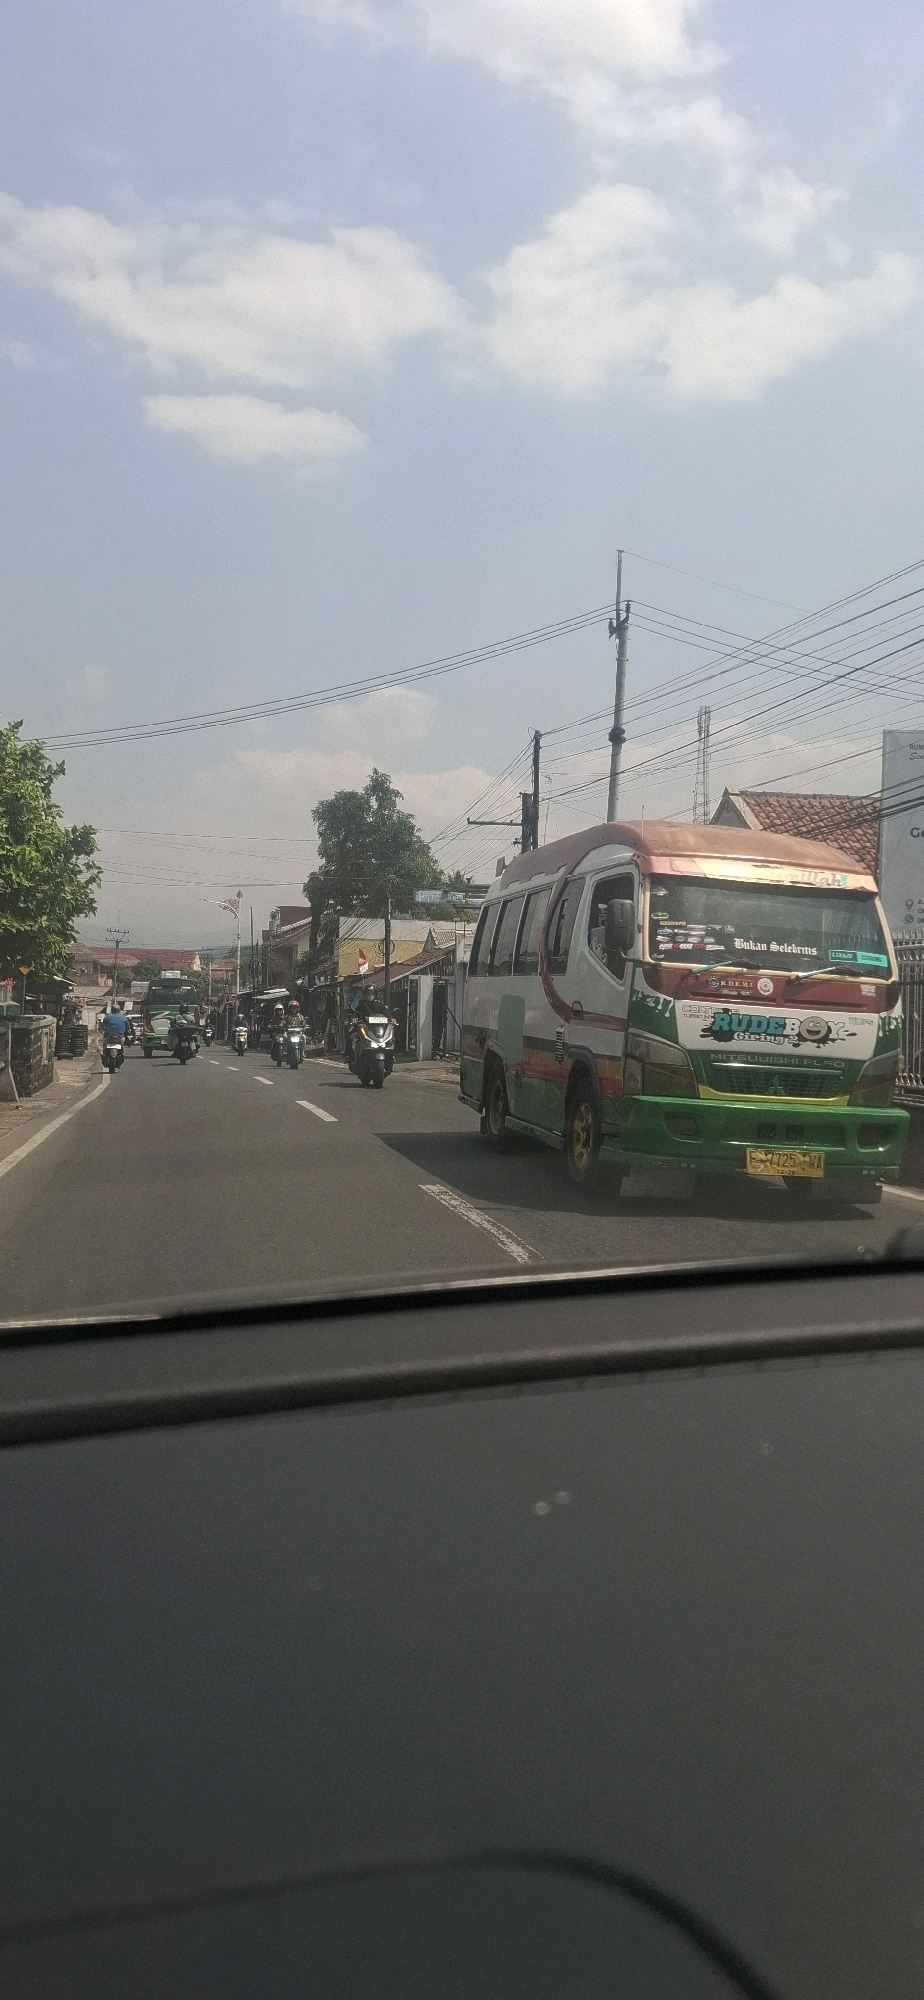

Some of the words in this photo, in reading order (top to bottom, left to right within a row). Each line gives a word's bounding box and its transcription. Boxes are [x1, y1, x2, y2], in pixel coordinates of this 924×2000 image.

[734, 938, 767, 951] Bukan
[733, 1031, 784, 1045] Giring
[788, 1035, 799, 1045] 2
[710, 1053, 800, 1065] MITSUBISHI
[768, 1151, 797, 1168] 7725
